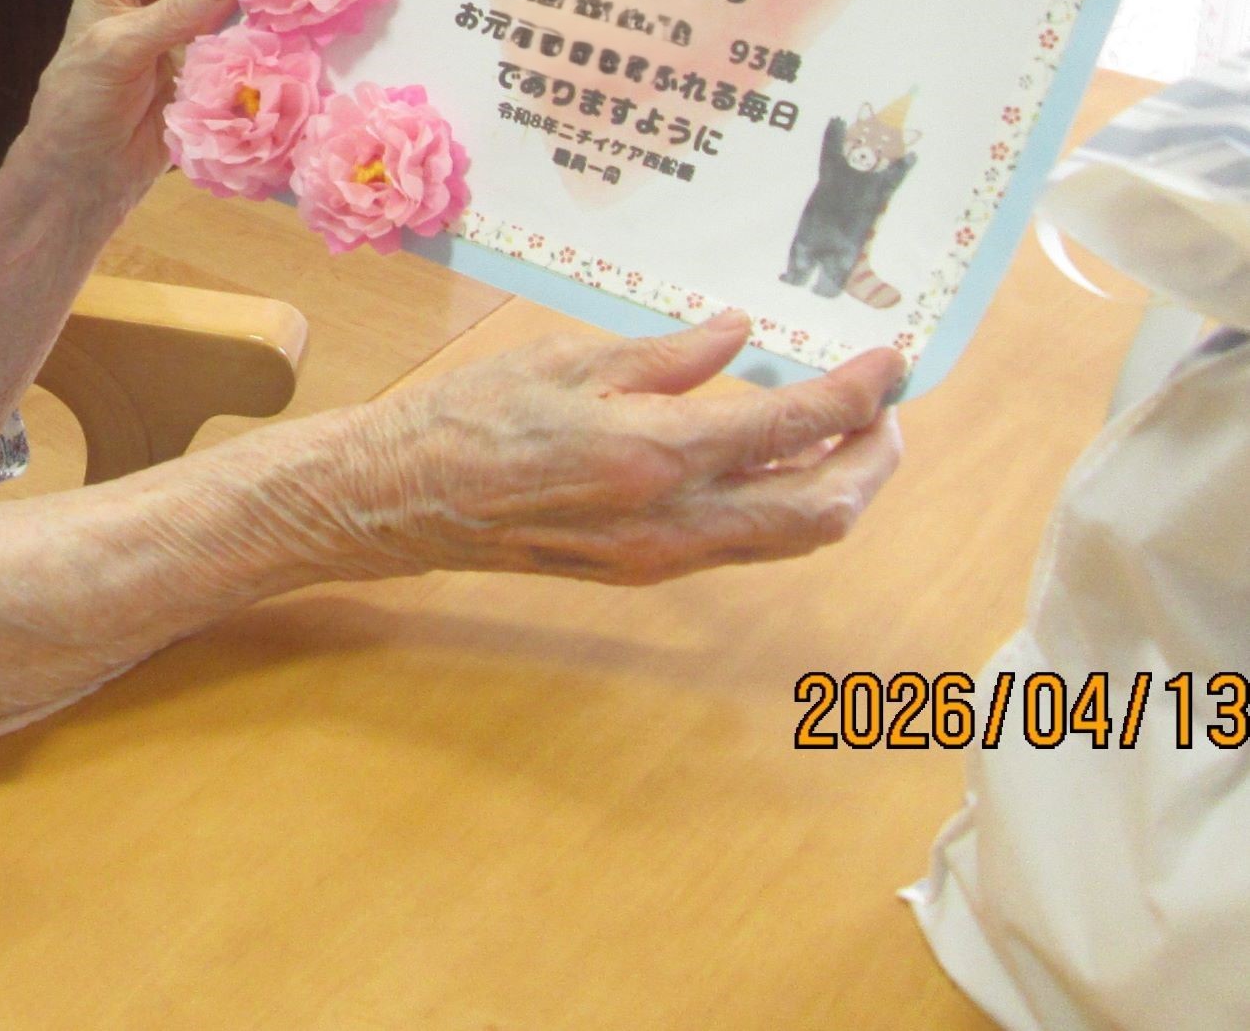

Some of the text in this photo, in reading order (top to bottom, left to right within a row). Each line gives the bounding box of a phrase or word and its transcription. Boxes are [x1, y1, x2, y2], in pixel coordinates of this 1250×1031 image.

[497, 60, 725, 157] でありますように
